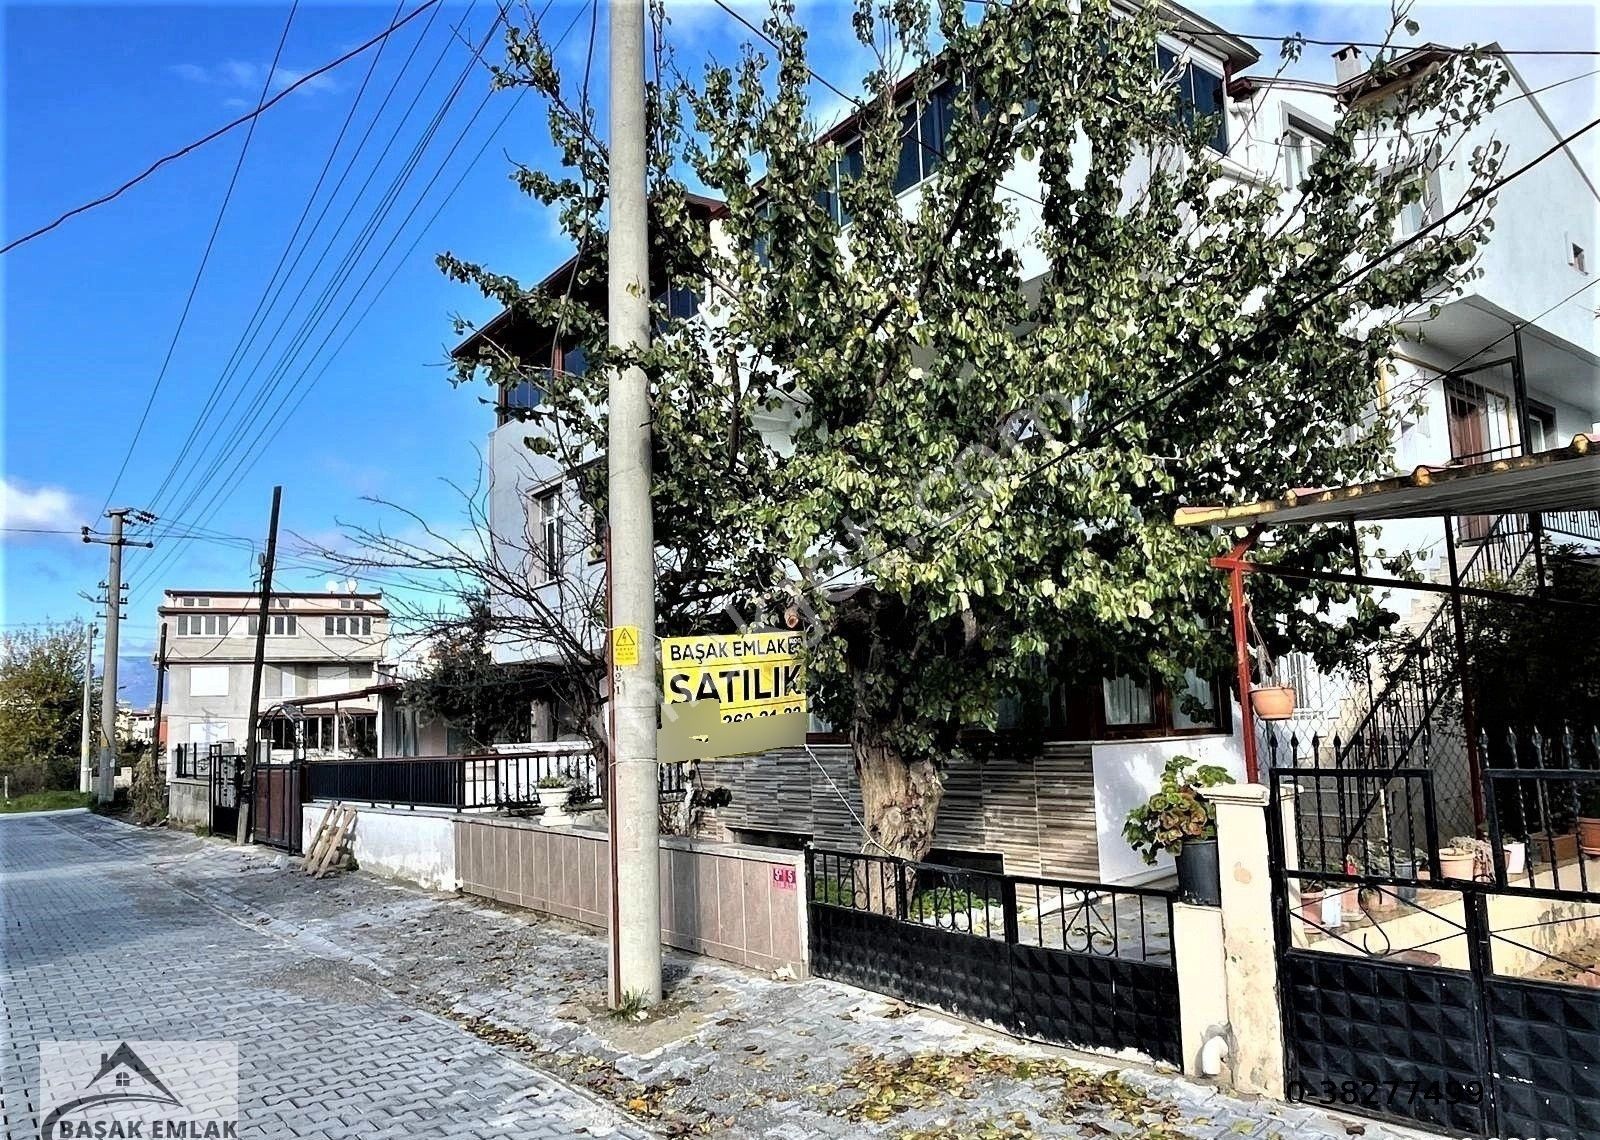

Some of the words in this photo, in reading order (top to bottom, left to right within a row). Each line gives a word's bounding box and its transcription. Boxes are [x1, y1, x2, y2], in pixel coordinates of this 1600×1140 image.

[670, 642, 728, 664] BAŞAK
[733, 638, 787, 657] EMLAK
[669, 664, 803, 704] SATILIK
